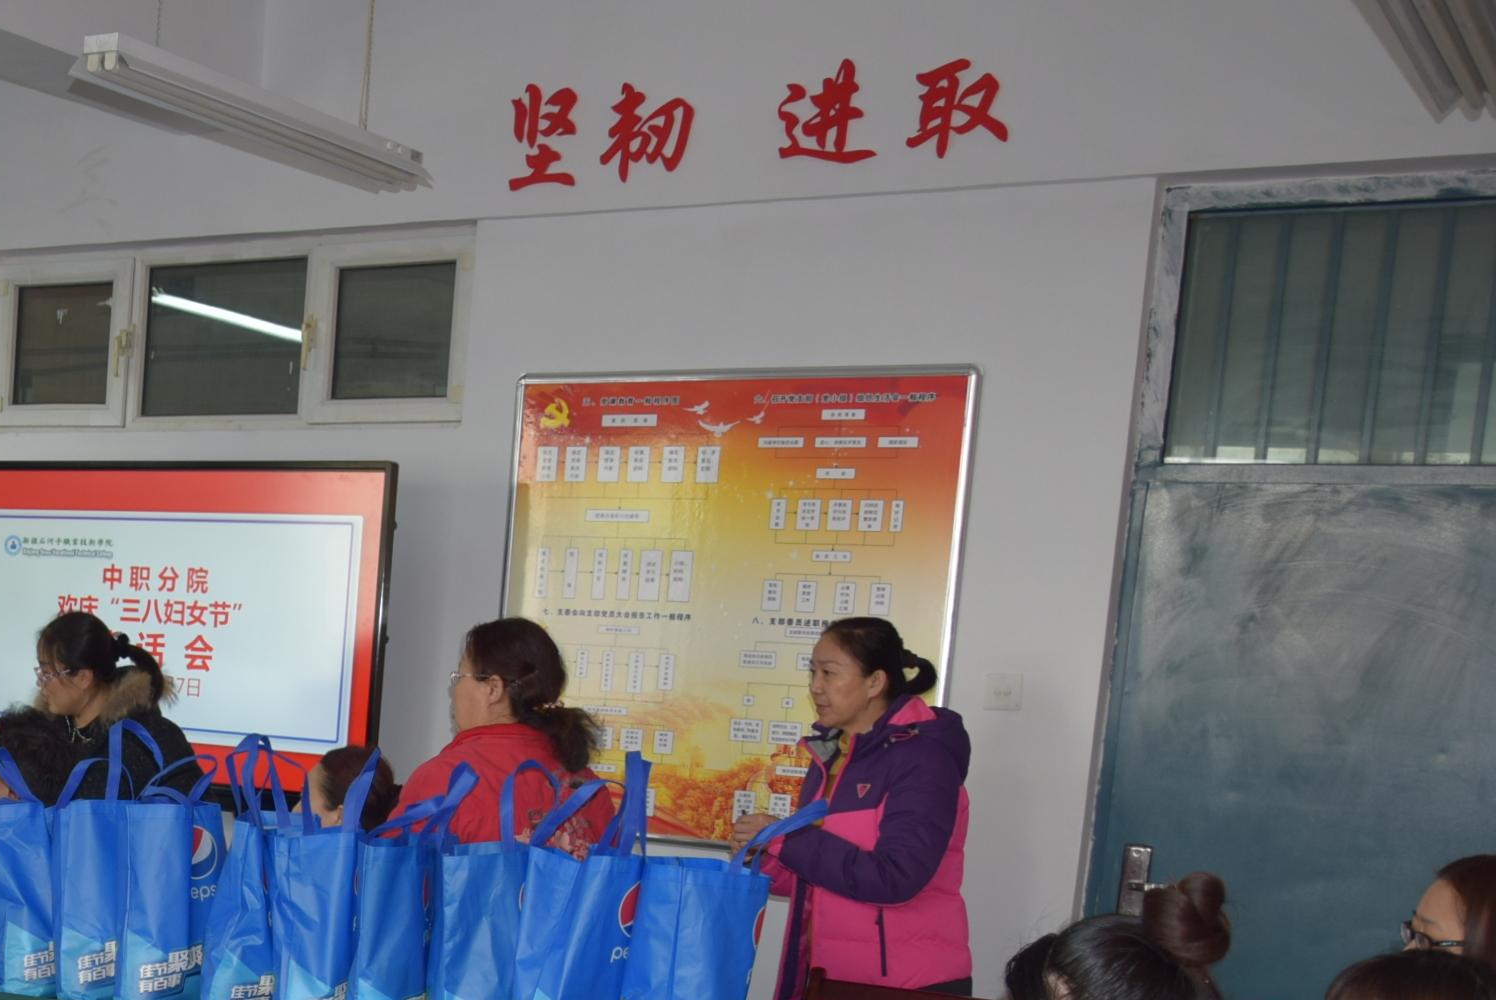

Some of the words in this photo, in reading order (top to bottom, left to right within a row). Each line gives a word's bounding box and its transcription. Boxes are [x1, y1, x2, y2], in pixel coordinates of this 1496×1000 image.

[508, 83, 695, 191] 坚韧
[779, 58, 1010, 164] 进取
[102, 563, 209, 594] 中职分院
[139, 974, 183, 994] 有百事
